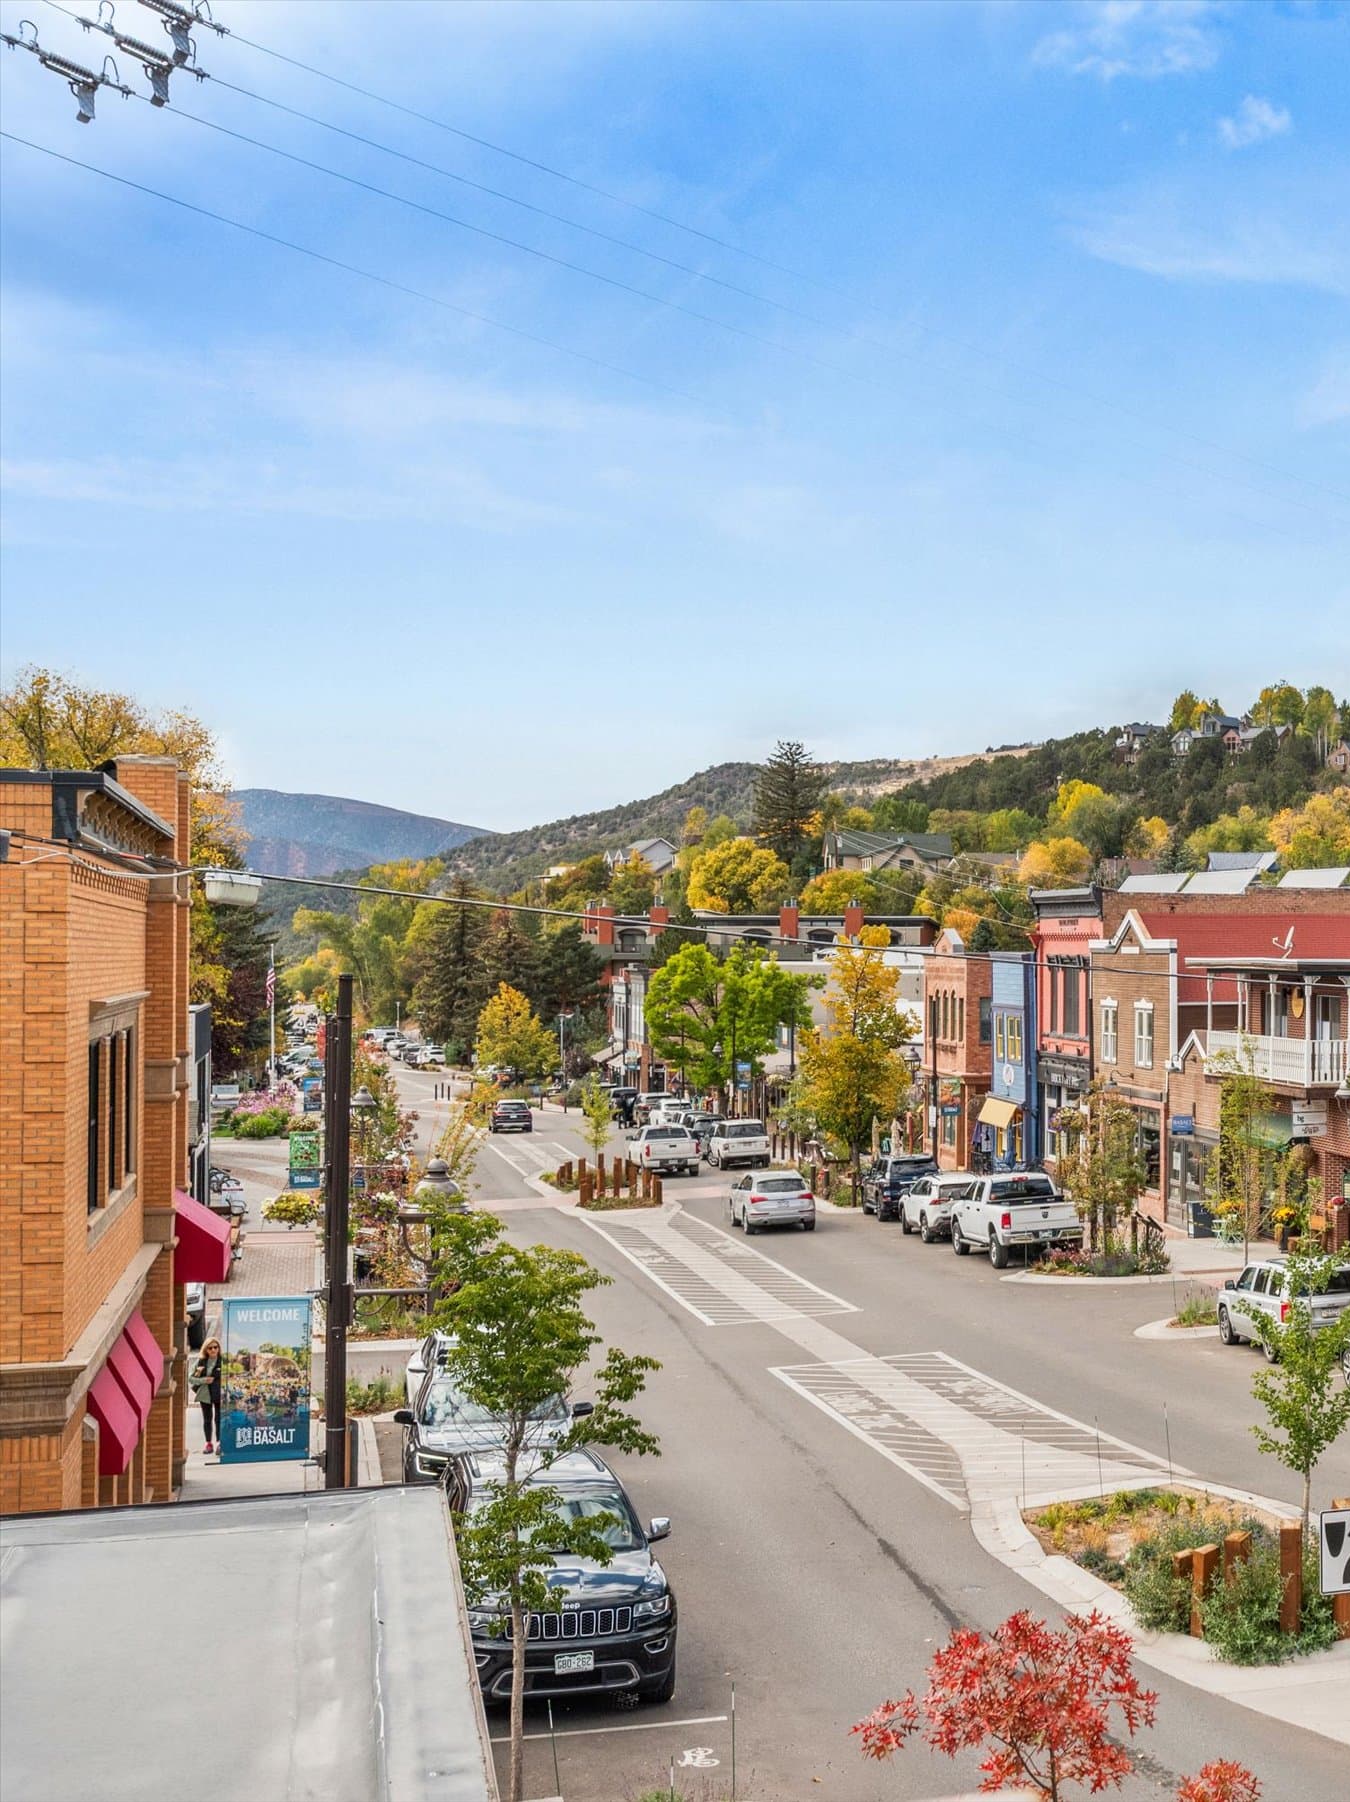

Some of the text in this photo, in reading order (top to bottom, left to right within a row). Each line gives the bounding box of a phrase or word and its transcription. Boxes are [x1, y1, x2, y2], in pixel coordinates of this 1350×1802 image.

[237, 1308, 300, 1323] WELCOME
[253, 1428, 296, 1446] BASALT
[561, 1602, 581, 1610] Jeep
